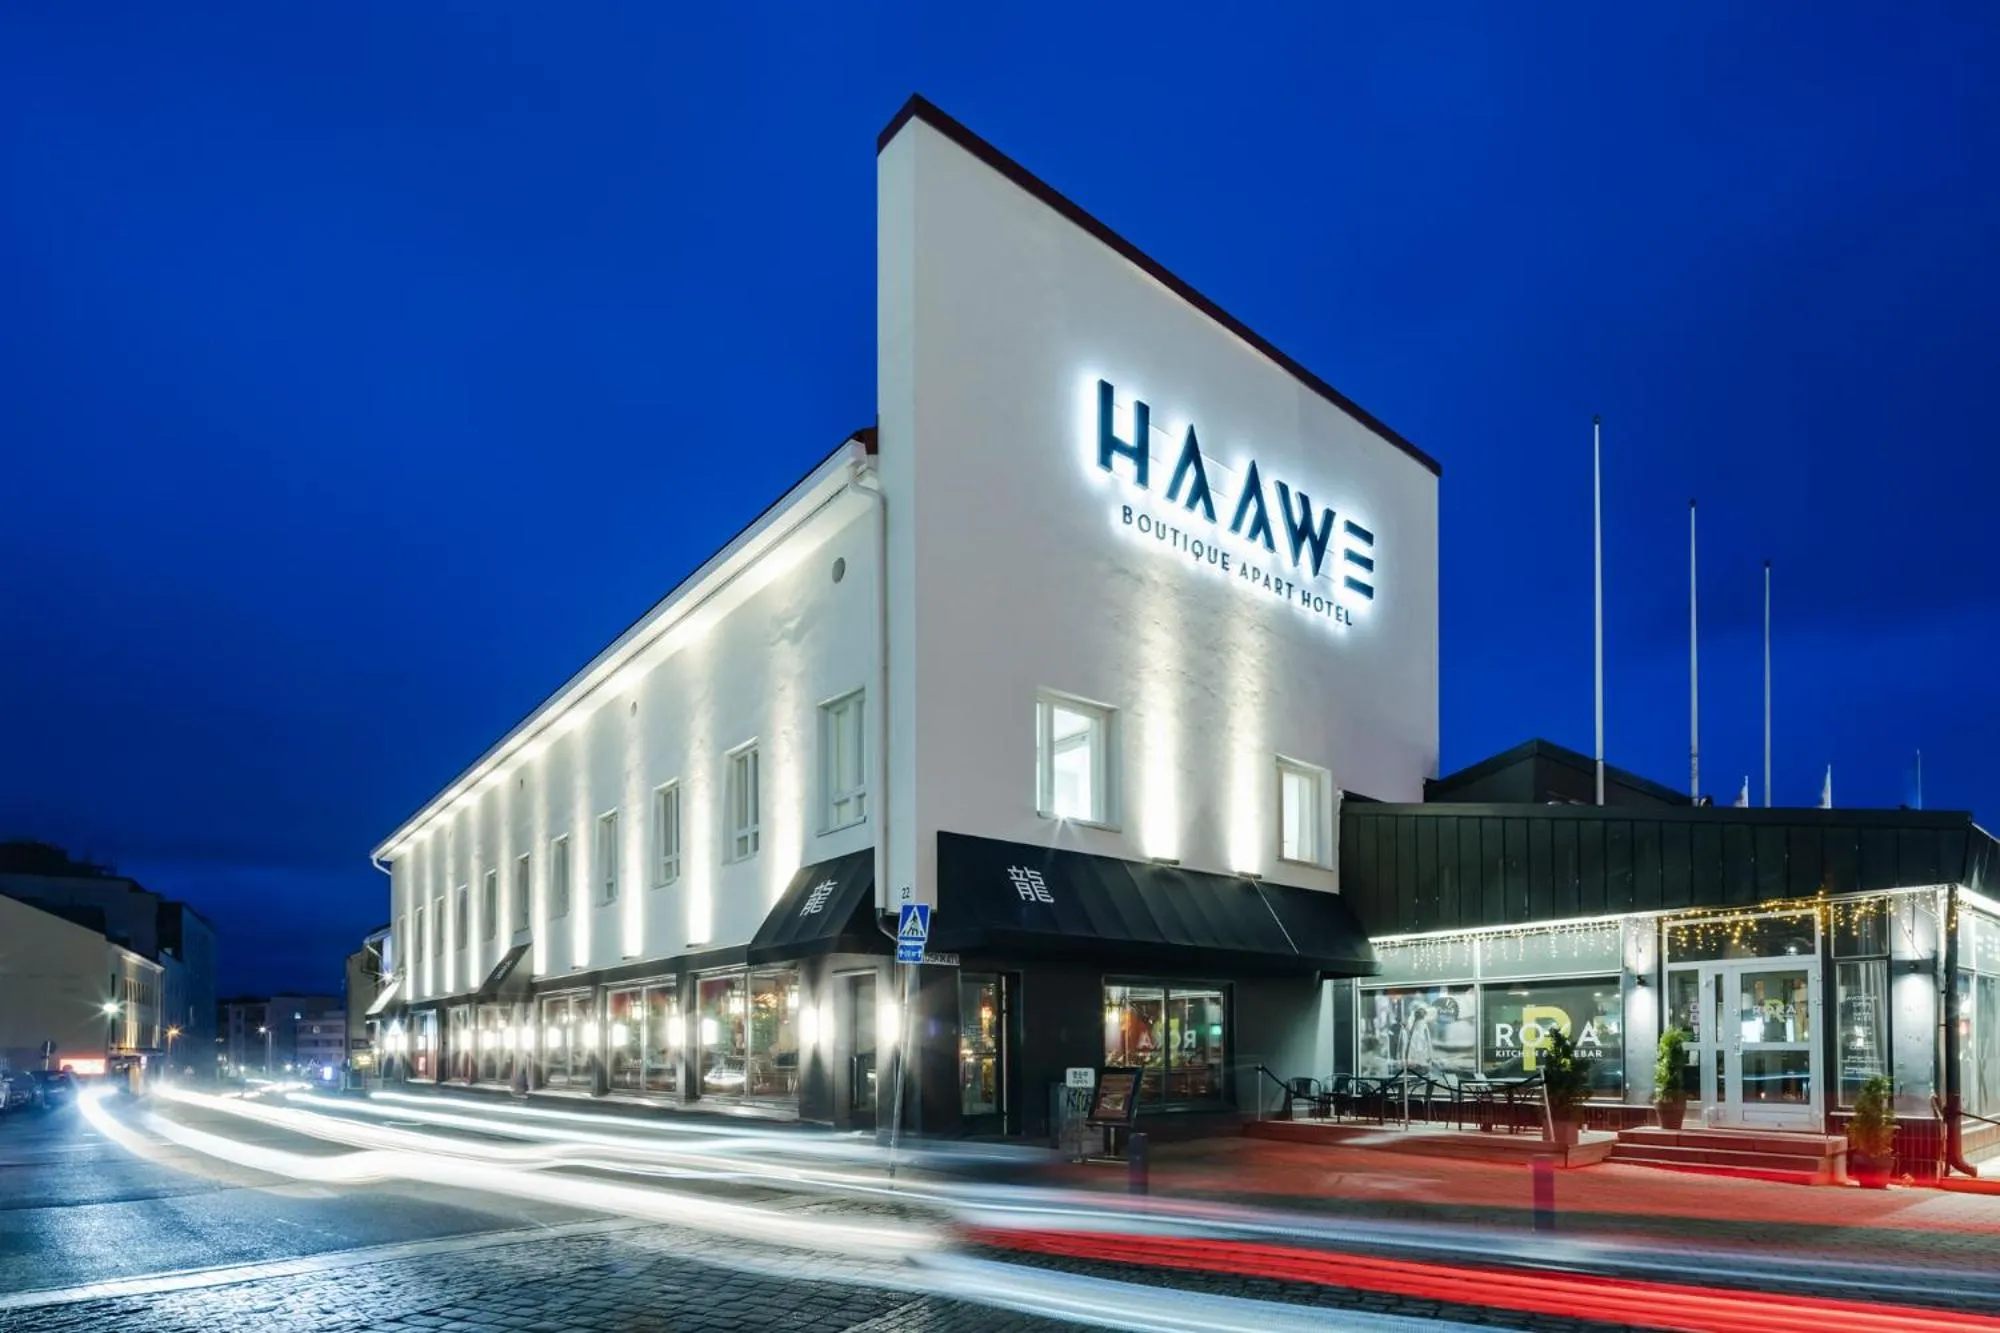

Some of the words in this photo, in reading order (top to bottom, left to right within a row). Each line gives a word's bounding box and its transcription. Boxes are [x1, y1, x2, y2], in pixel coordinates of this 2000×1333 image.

[1097, 378, 1374, 600] HAAWE
[1121, 504, 1231, 572] BOUTIQUE
[1239, 559, 1294, 601] APART
[1301, 589, 1353, 627] HOTEL
[901, 886, 911, 900] 22
[1007, 864, 1055, 903] 龍
[1495, 1020, 1602, 1048] ROA
